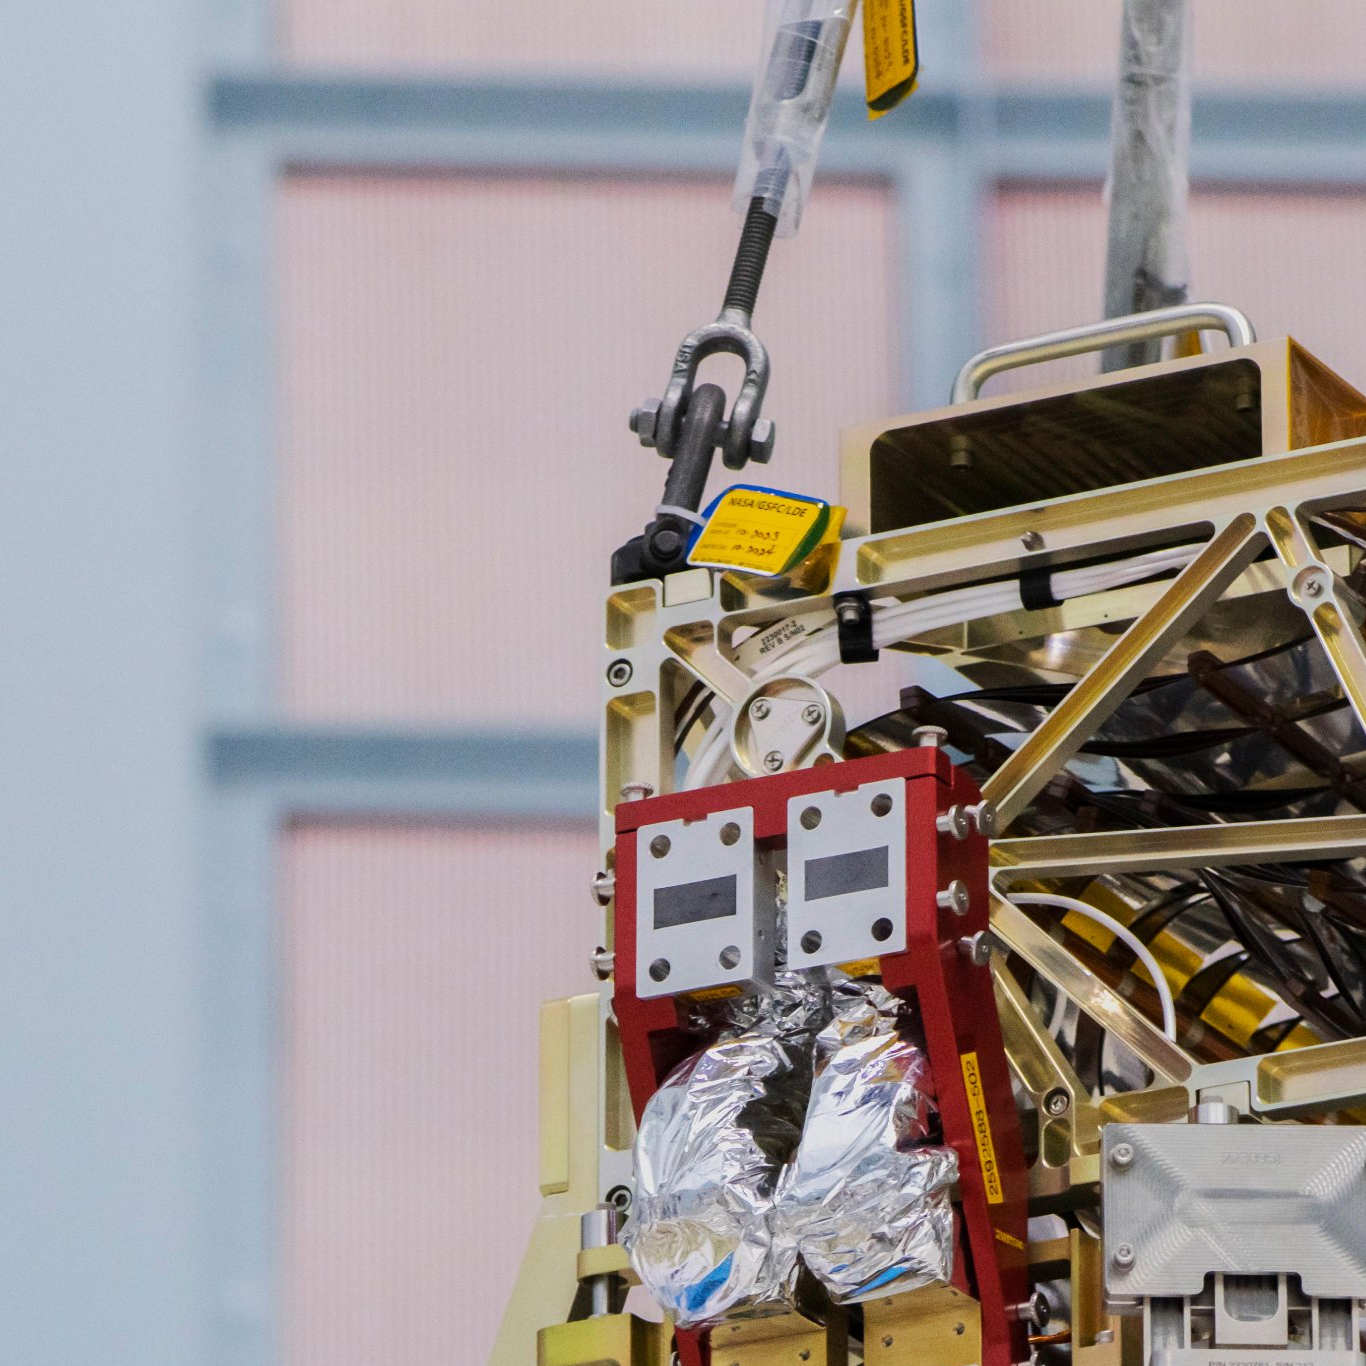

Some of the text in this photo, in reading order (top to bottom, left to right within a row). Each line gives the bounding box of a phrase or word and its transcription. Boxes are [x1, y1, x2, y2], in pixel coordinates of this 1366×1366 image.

[728, 497, 809, 518] NASA/GSFC/LDE
[759, 643, 776, 654] REV
[965, 1060, 999, 1196] 2592588-502
